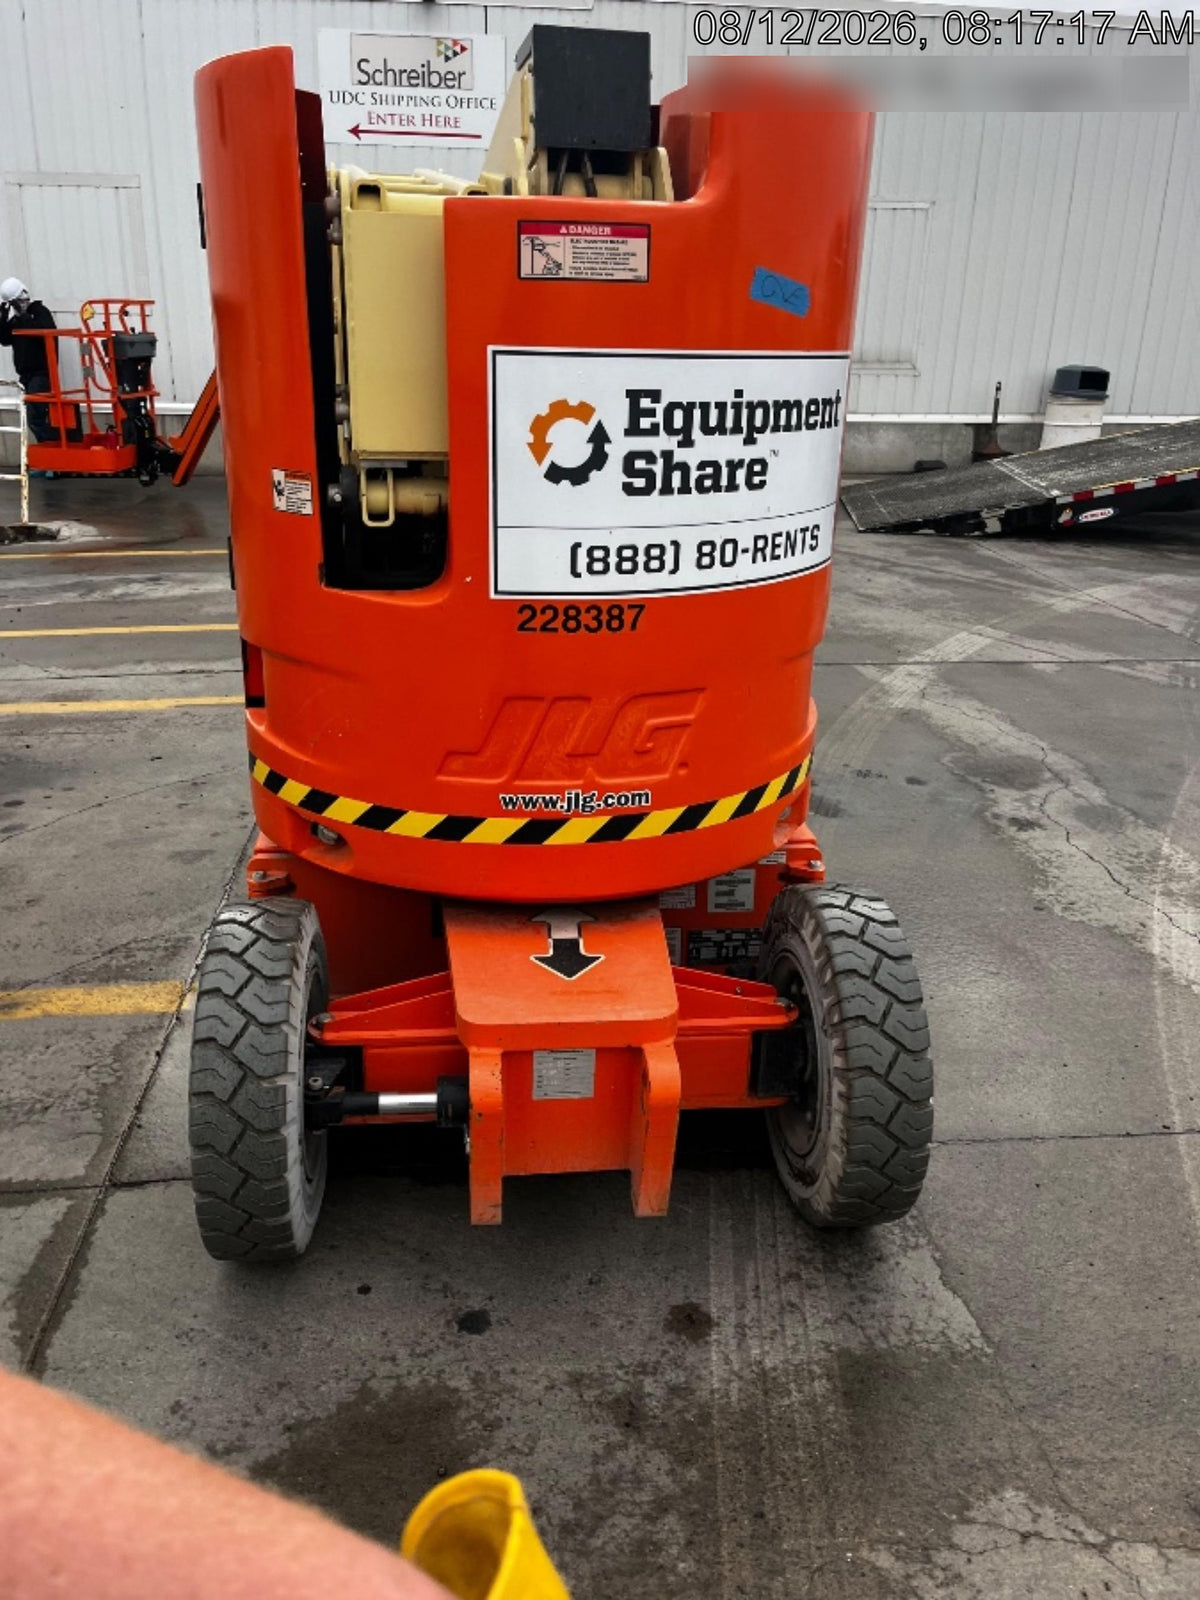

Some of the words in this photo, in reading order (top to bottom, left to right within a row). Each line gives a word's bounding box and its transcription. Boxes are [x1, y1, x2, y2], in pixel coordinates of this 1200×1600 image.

[356, 57, 466, 90] Schreiber
[328, 90, 366, 107] UDC
[370, 91, 442, 108] SHIPPING
[445, 95, 497, 111] OFFICE
[367, 111, 416, 128] ENTER
[421, 113, 461, 129] HERE
[568, 225, 612, 236] DANGER
[623, 388, 842, 449] Equipment
[621, 449, 769, 497] Share
[569, 540, 682, 579] (888)
[695, 524, 821, 571] 80-RENTS
[516, 603, 647, 634] 228387
[500, 788, 651, 814] www.jlg.com
